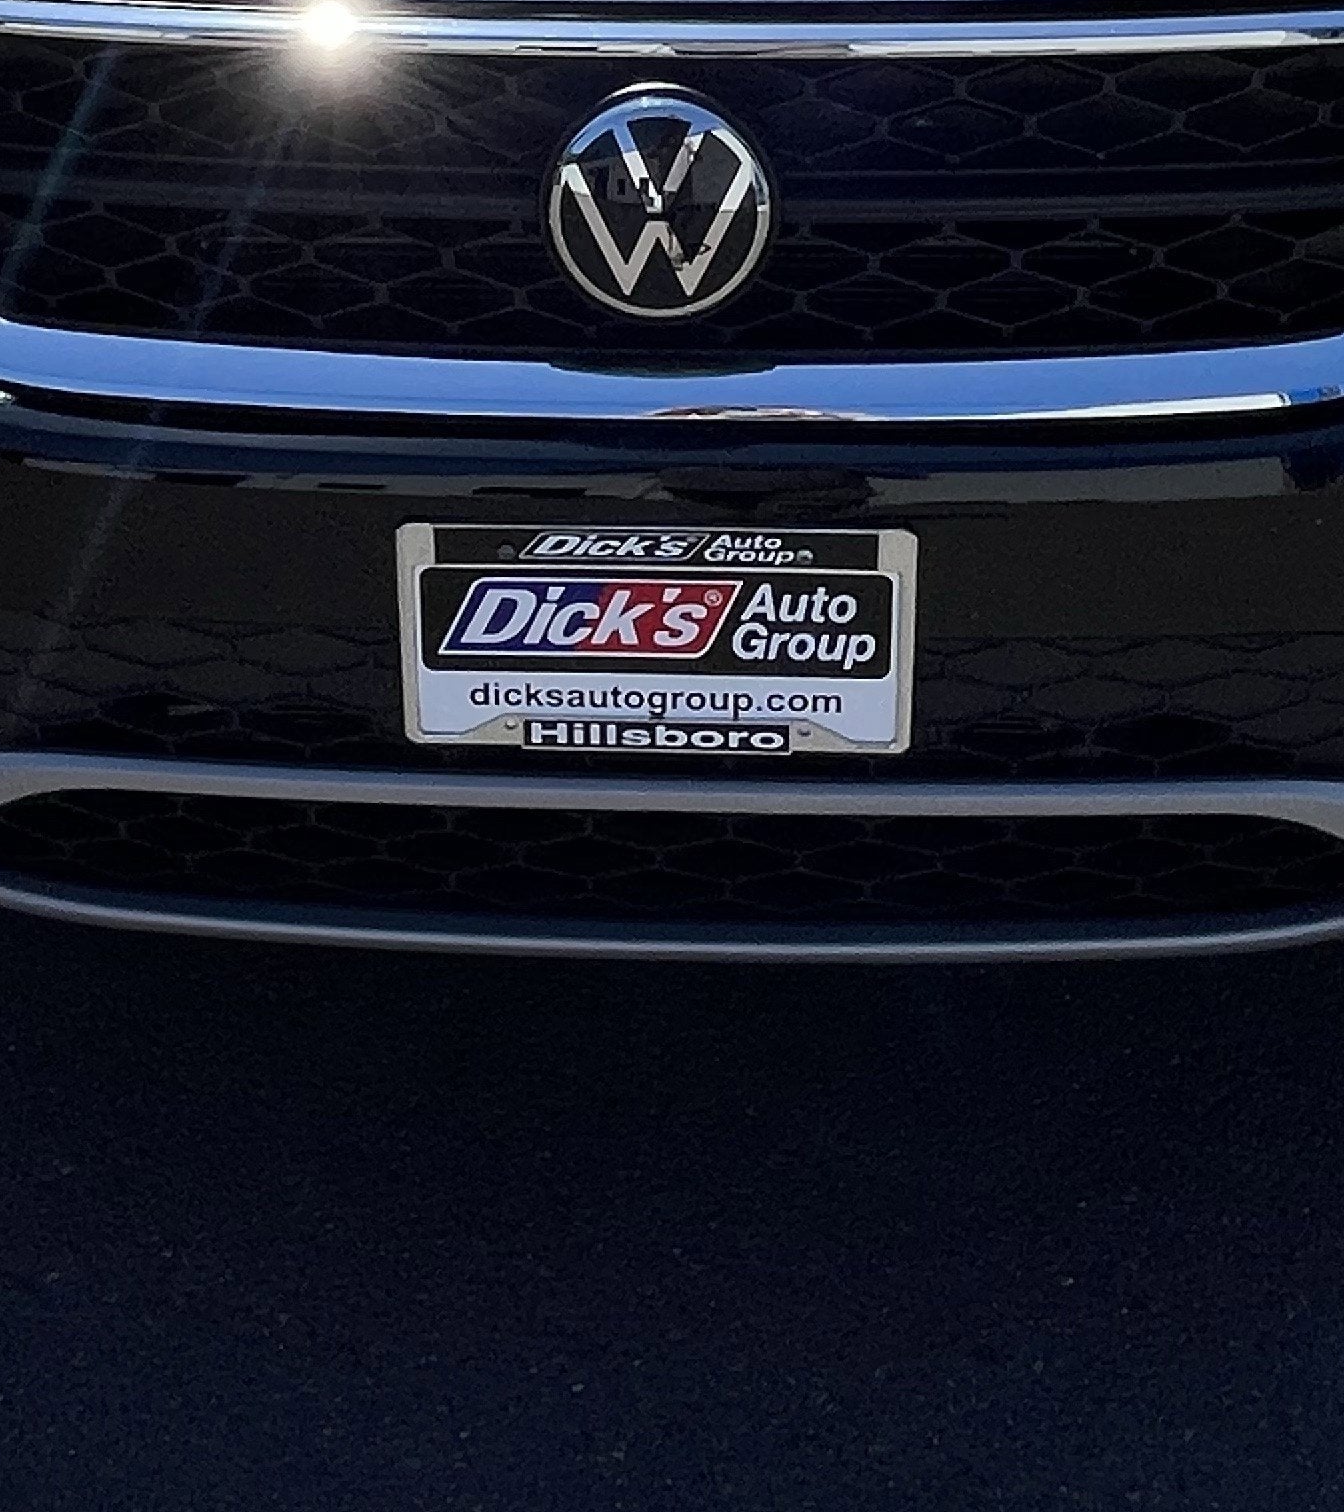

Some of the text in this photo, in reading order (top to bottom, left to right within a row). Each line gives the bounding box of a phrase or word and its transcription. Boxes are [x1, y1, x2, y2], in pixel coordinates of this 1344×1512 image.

[532, 534, 782, 557] Dick's Auto
[704, 547, 795, 565] Group
[460, 583, 857, 647] Dick's Auto
[732, 624, 877, 670] Group
[469, 683, 843, 719] dicksautogroup.com
[529, 722, 785, 750] Hillsboro
